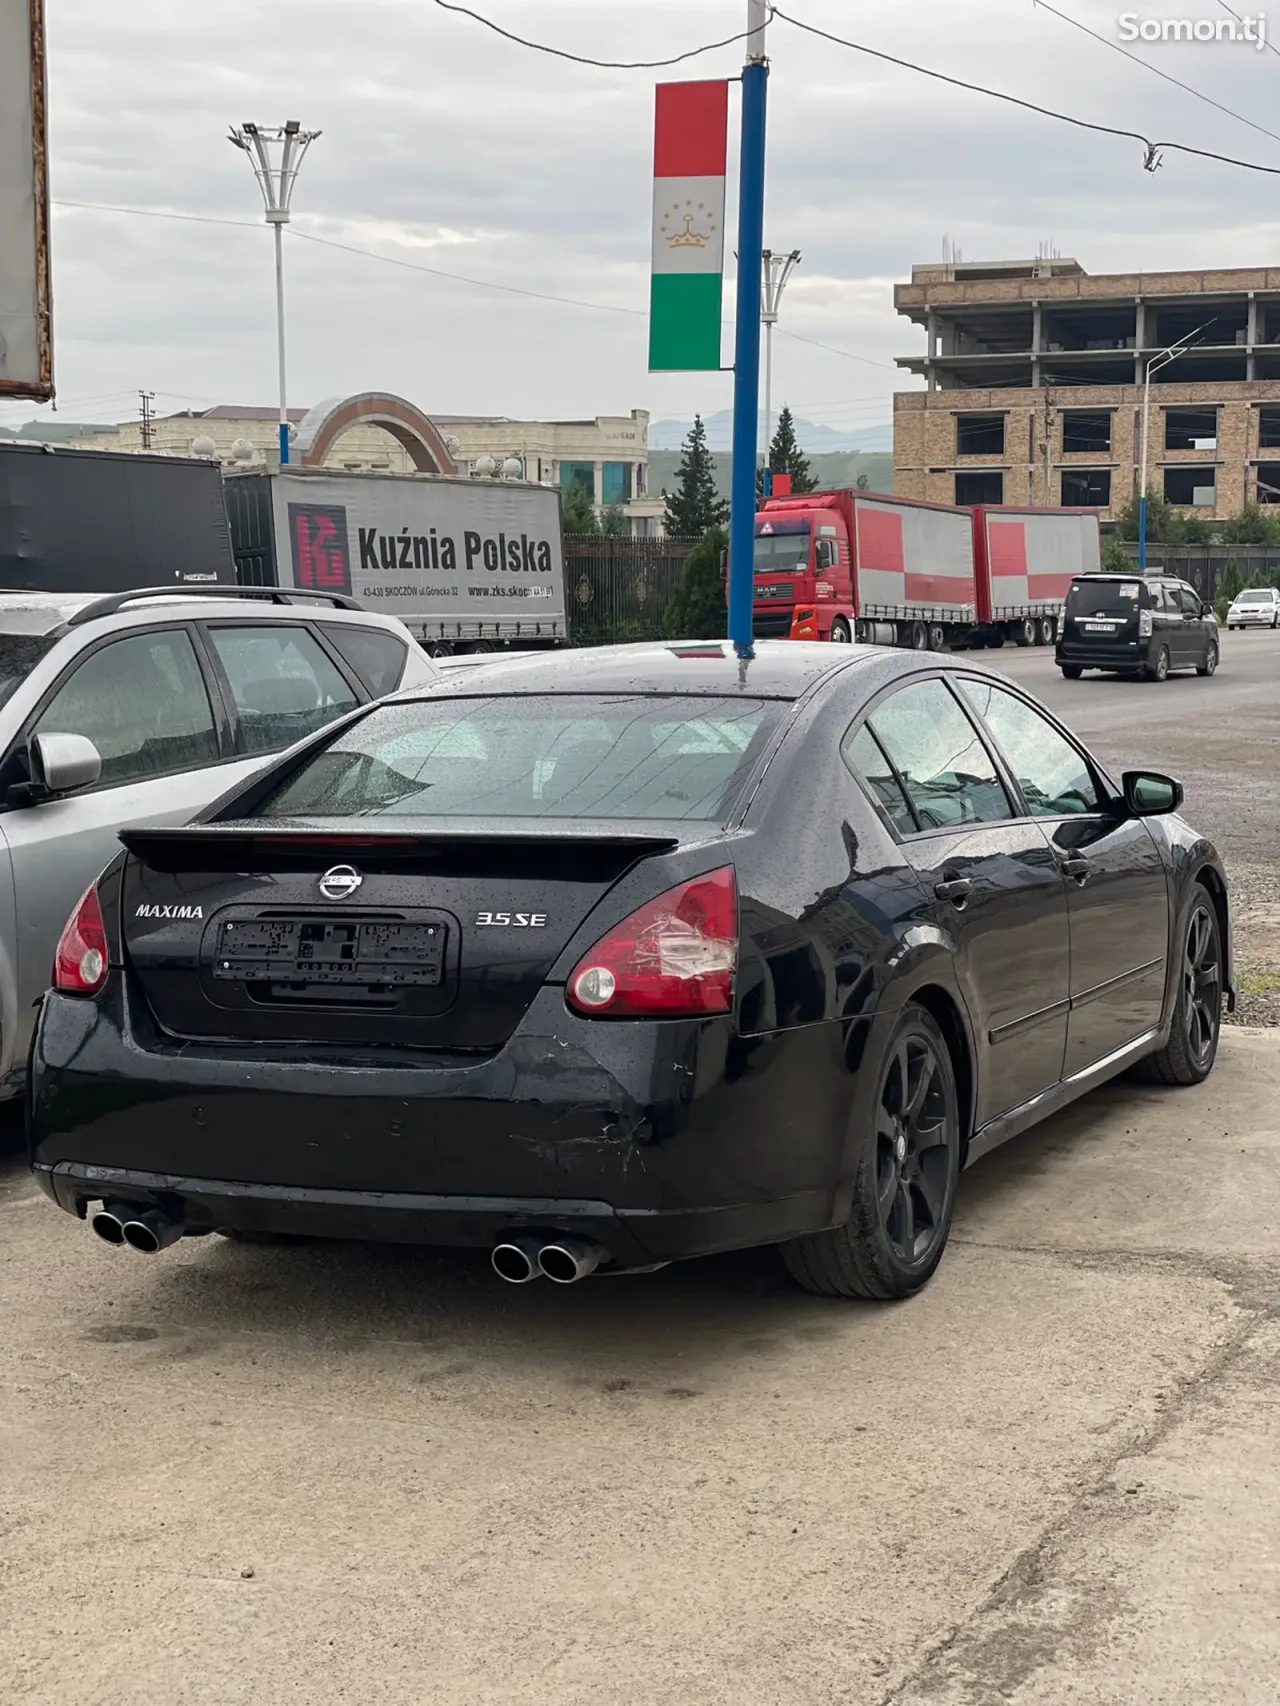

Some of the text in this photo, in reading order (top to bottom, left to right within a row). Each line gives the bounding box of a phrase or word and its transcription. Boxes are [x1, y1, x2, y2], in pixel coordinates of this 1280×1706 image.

[358, 527, 552, 573] Kuźnia Polska
[363, 587, 384, 597] 43-430
[451, 586, 459, 596] 32
[135, 904, 204, 919] MAXIMA
[512, 913, 547, 927] SE
